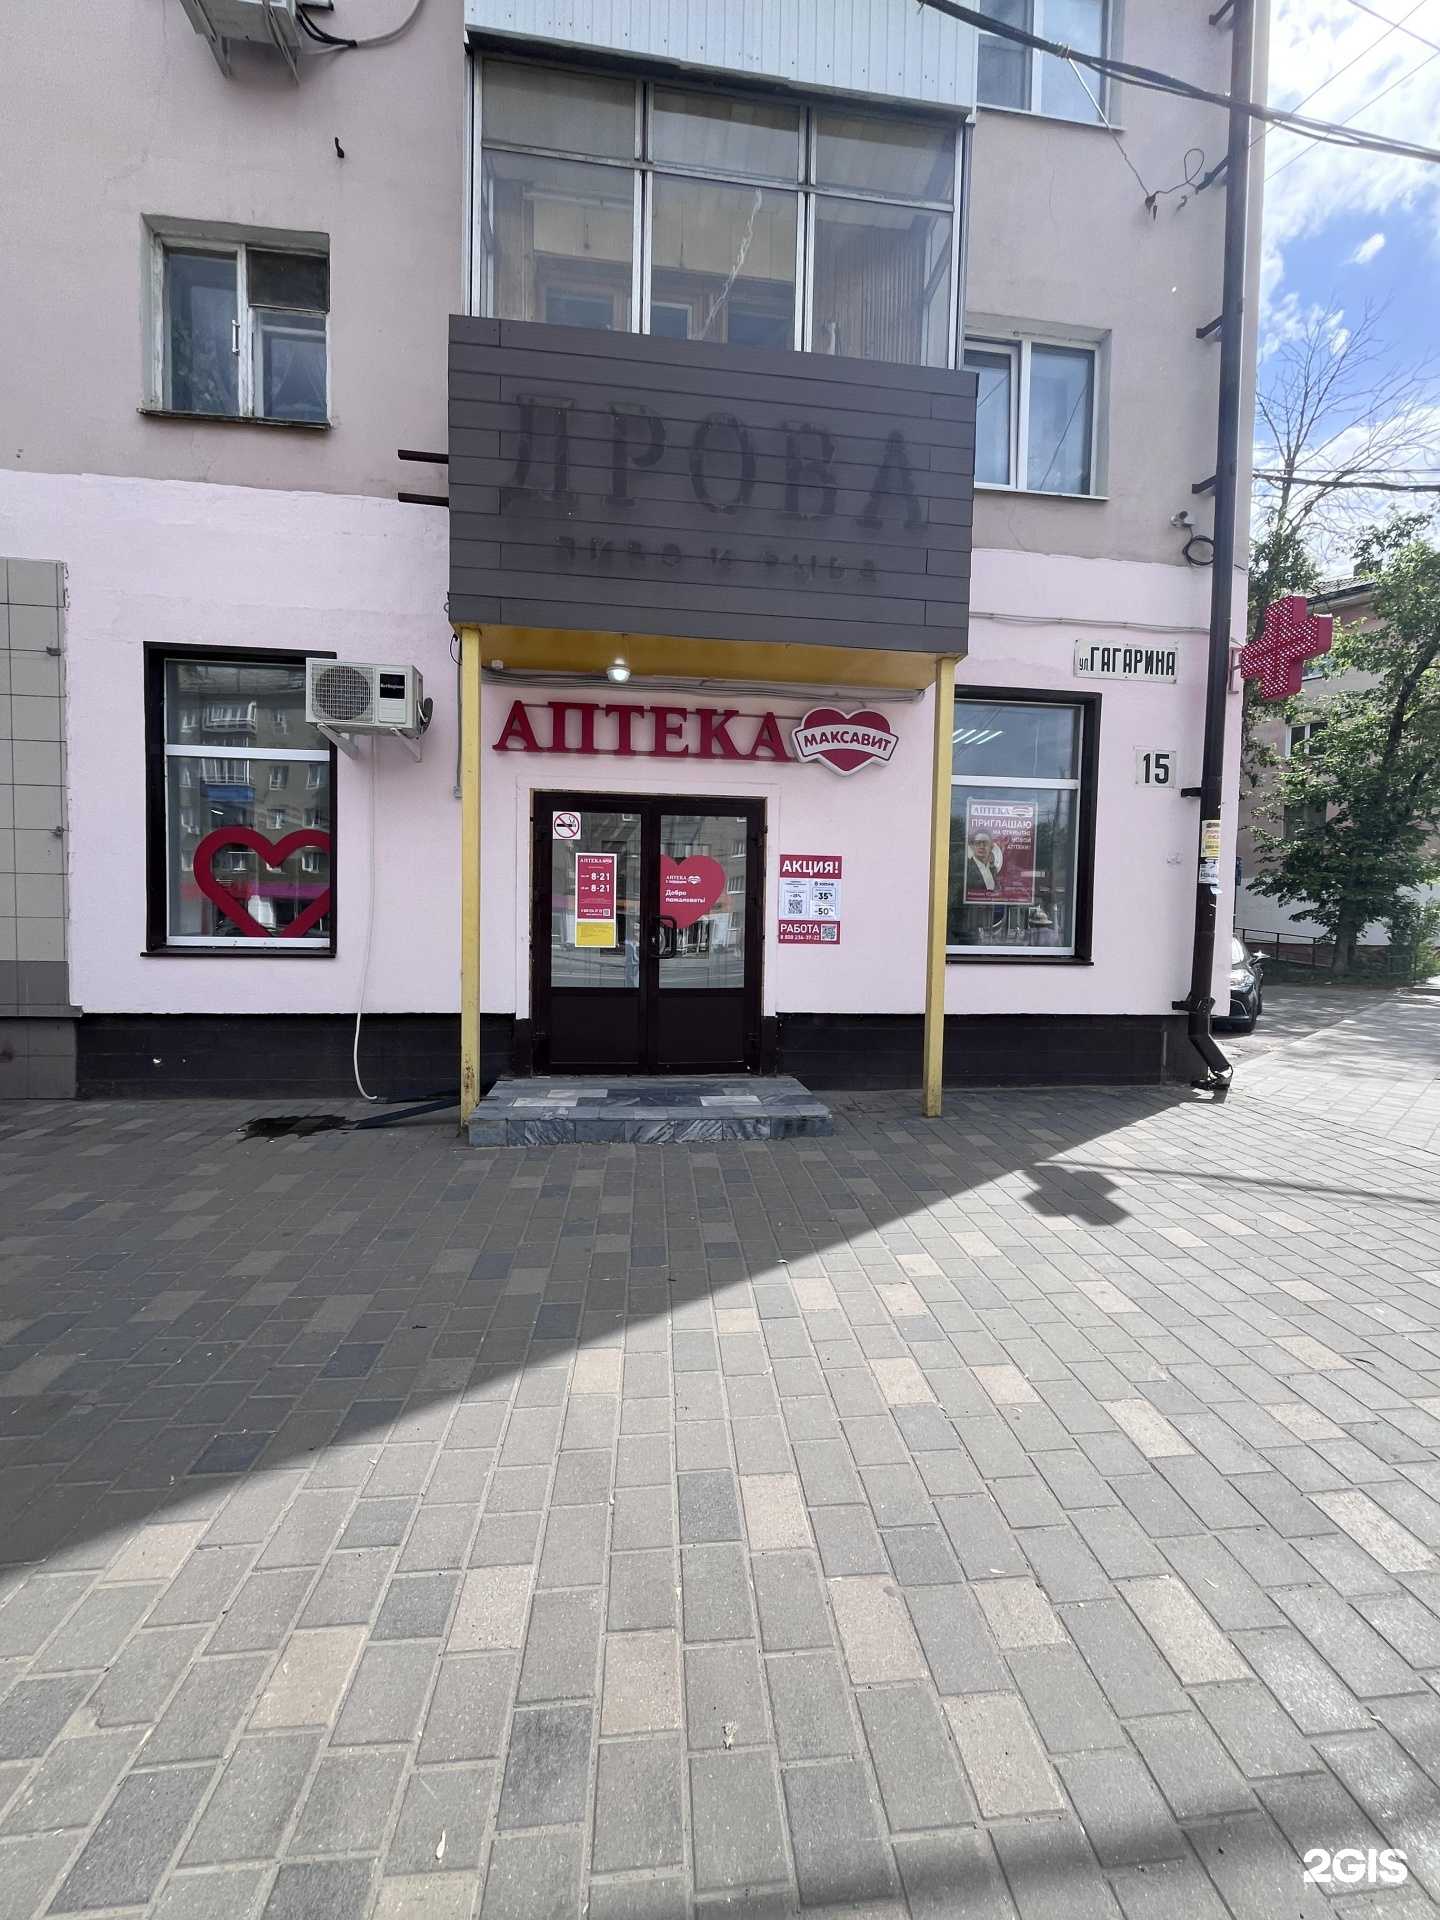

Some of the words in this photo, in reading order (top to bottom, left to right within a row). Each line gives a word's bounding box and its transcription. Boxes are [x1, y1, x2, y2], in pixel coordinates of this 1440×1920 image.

[1090, 646, 1176, 676] ГАГАРИНА
[492, 700, 793, 763] АПТЕКА
[803, 729, 892, 752] МАКСАВИТ
[1143, 753, 1170, 784] 15
[971, 818, 1032, 829] ПРИГЛАШАЮ
[782, 860, 839, 876] АКЦИЯ!
[780, 923, 820, 933] РАБОТА
